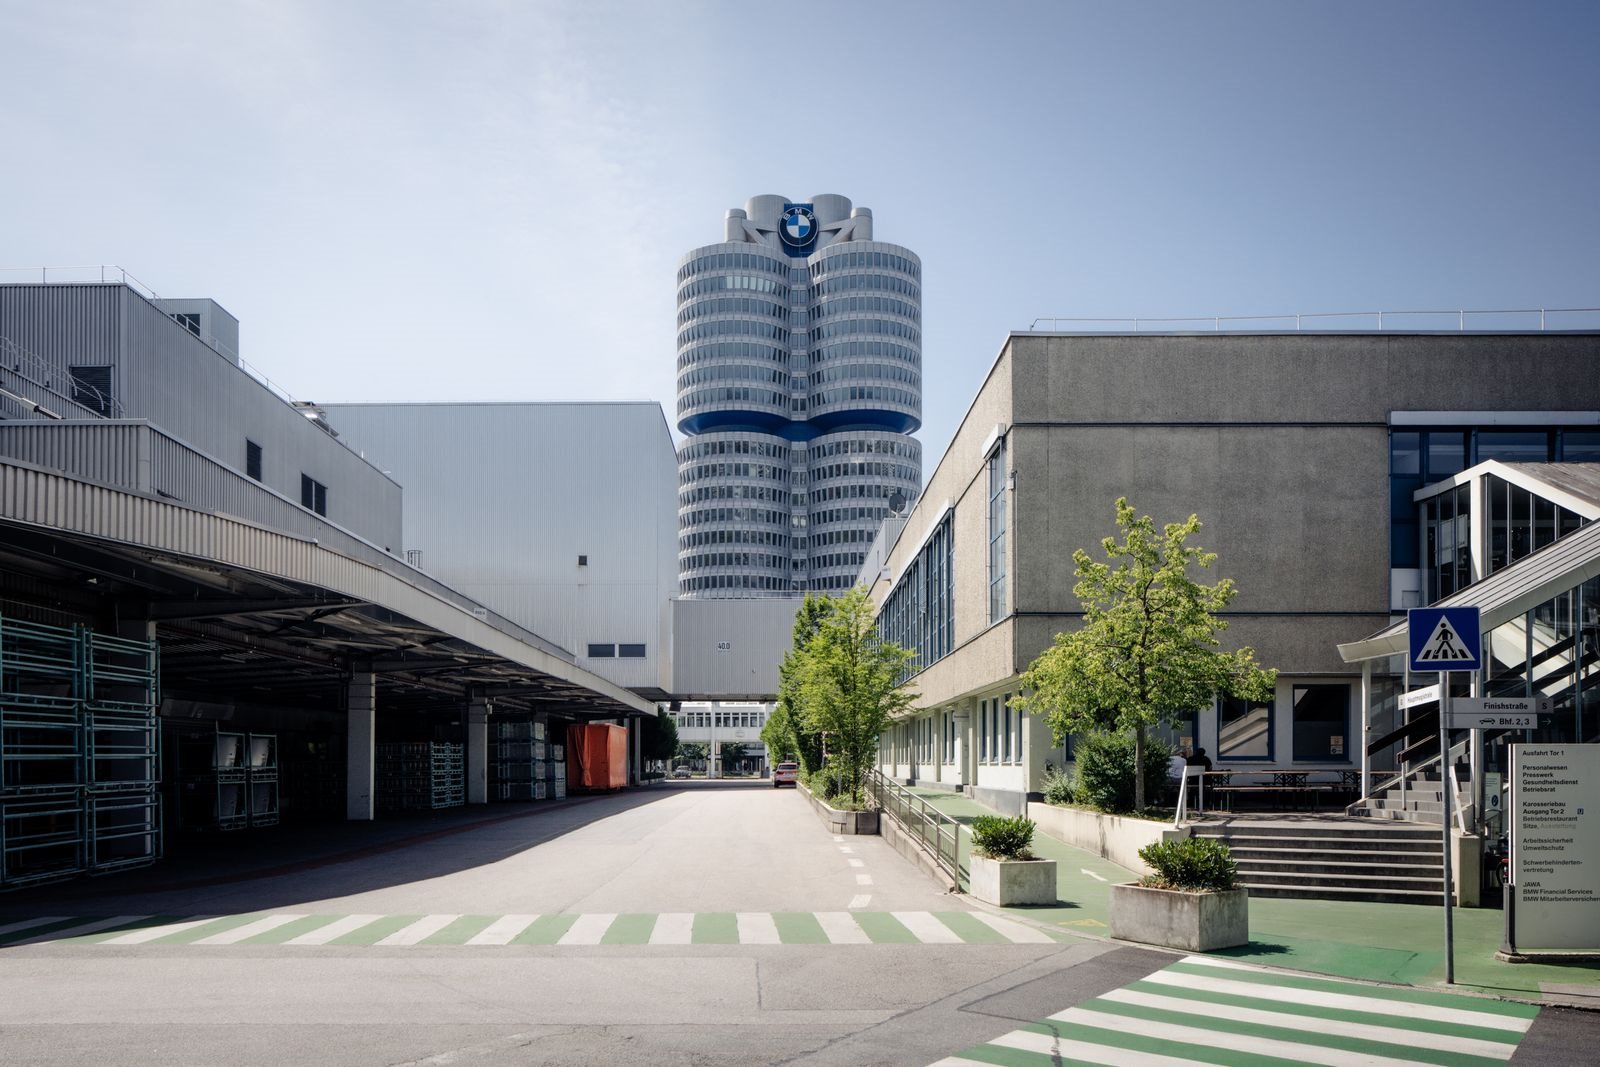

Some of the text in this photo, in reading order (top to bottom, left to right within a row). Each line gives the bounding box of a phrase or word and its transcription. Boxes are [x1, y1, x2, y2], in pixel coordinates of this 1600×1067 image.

[783, 208, 814, 220] BMW
[1483, 702, 1528, 710] Finishstraße
[1499, 718, 1514, 726] Bhf.
[1525, 718, 1530, 726] 3
